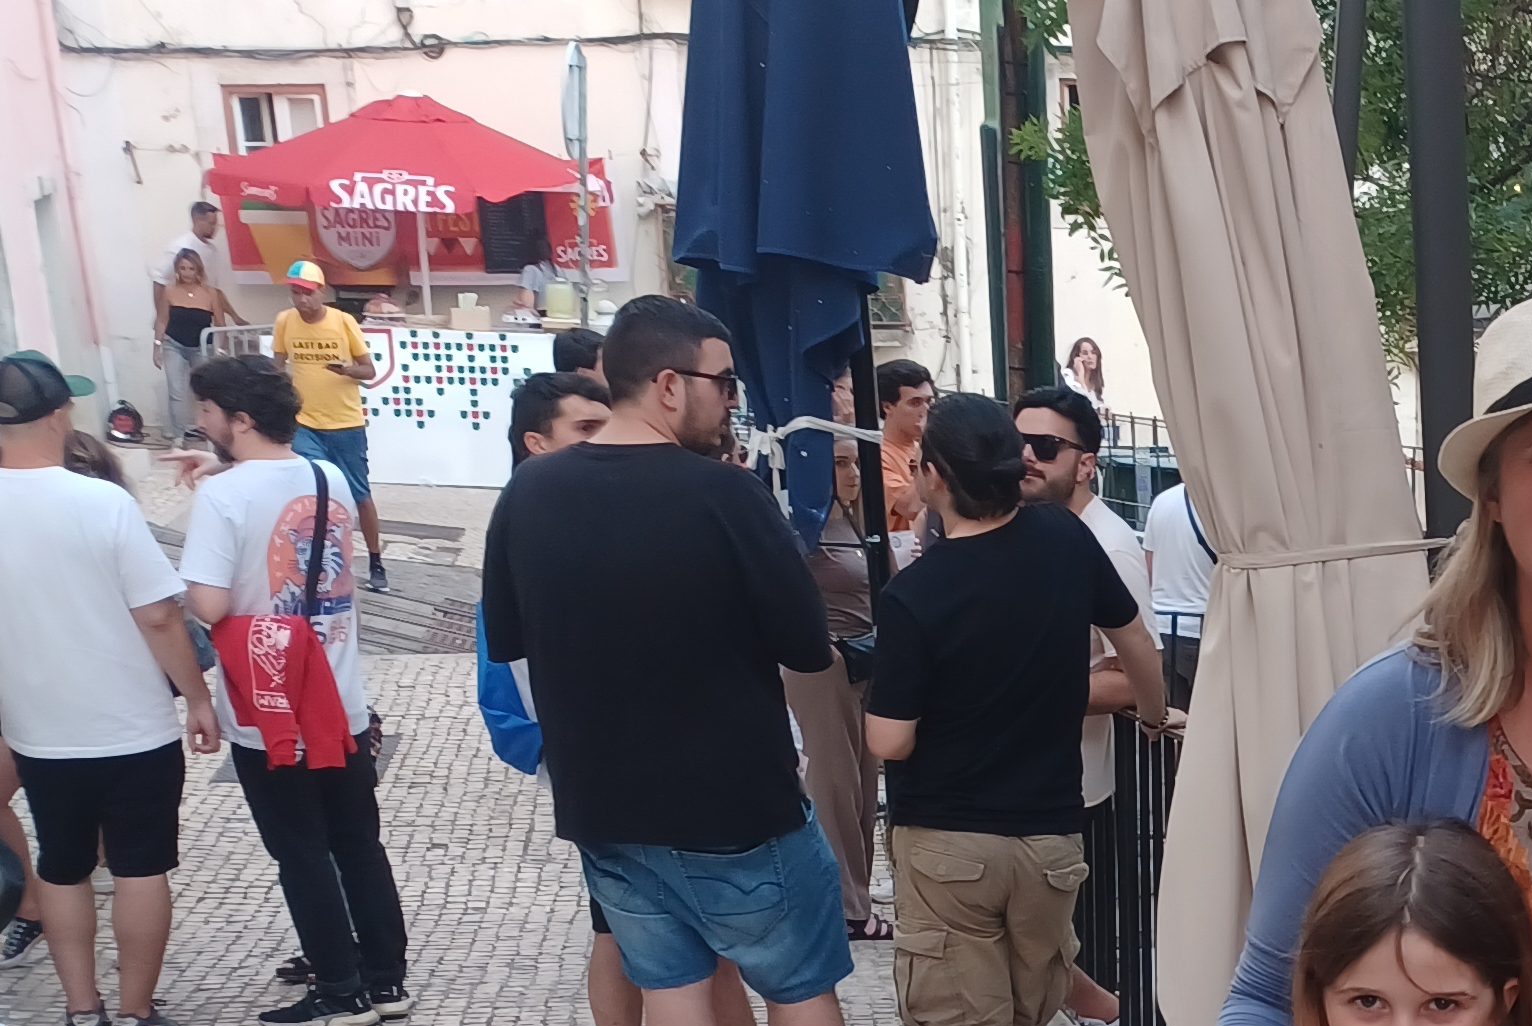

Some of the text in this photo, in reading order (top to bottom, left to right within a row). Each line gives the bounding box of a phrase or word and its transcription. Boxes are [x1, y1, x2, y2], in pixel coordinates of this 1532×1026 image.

[329, 179, 456, 213] SAGRES
[320, 208, 392, 231] SAGRES
[293, 341, 314, 349] LAST
[294, 352, 340, 361] DECISION
